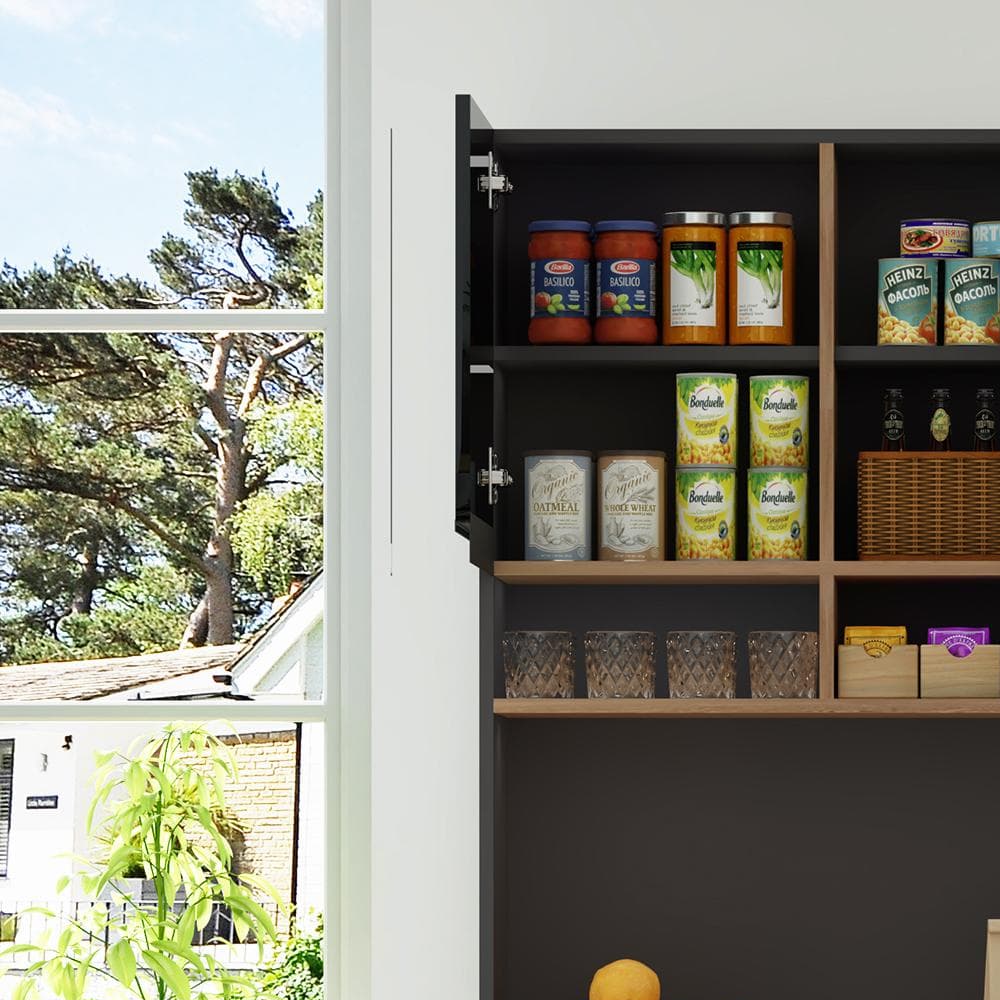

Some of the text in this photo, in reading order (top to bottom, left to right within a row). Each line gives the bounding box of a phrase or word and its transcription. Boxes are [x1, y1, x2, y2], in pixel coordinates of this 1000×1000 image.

[544, 277, 574, 286] BASILICO
[610, 277, 640, 286] BASILICO
[887, 268, 923, 287] HEINZ
[953, 268, 990, 287] HEINZ
[888, 284, 930, 304] ФАСОЛЬ
[954, 284, 996, 304] ФАСОЛЬ
[690, 395, 724, 410] Bonduelle
[763, 398, 797, 413] Bonduelle
[689, 490, 723, 505] Bonduelle
[761, 490, 796, 505] Bonduelle
[534, 502, 580, 512] OATMEAL
[605, 504, 656, 512] WHOLE WHEAT
